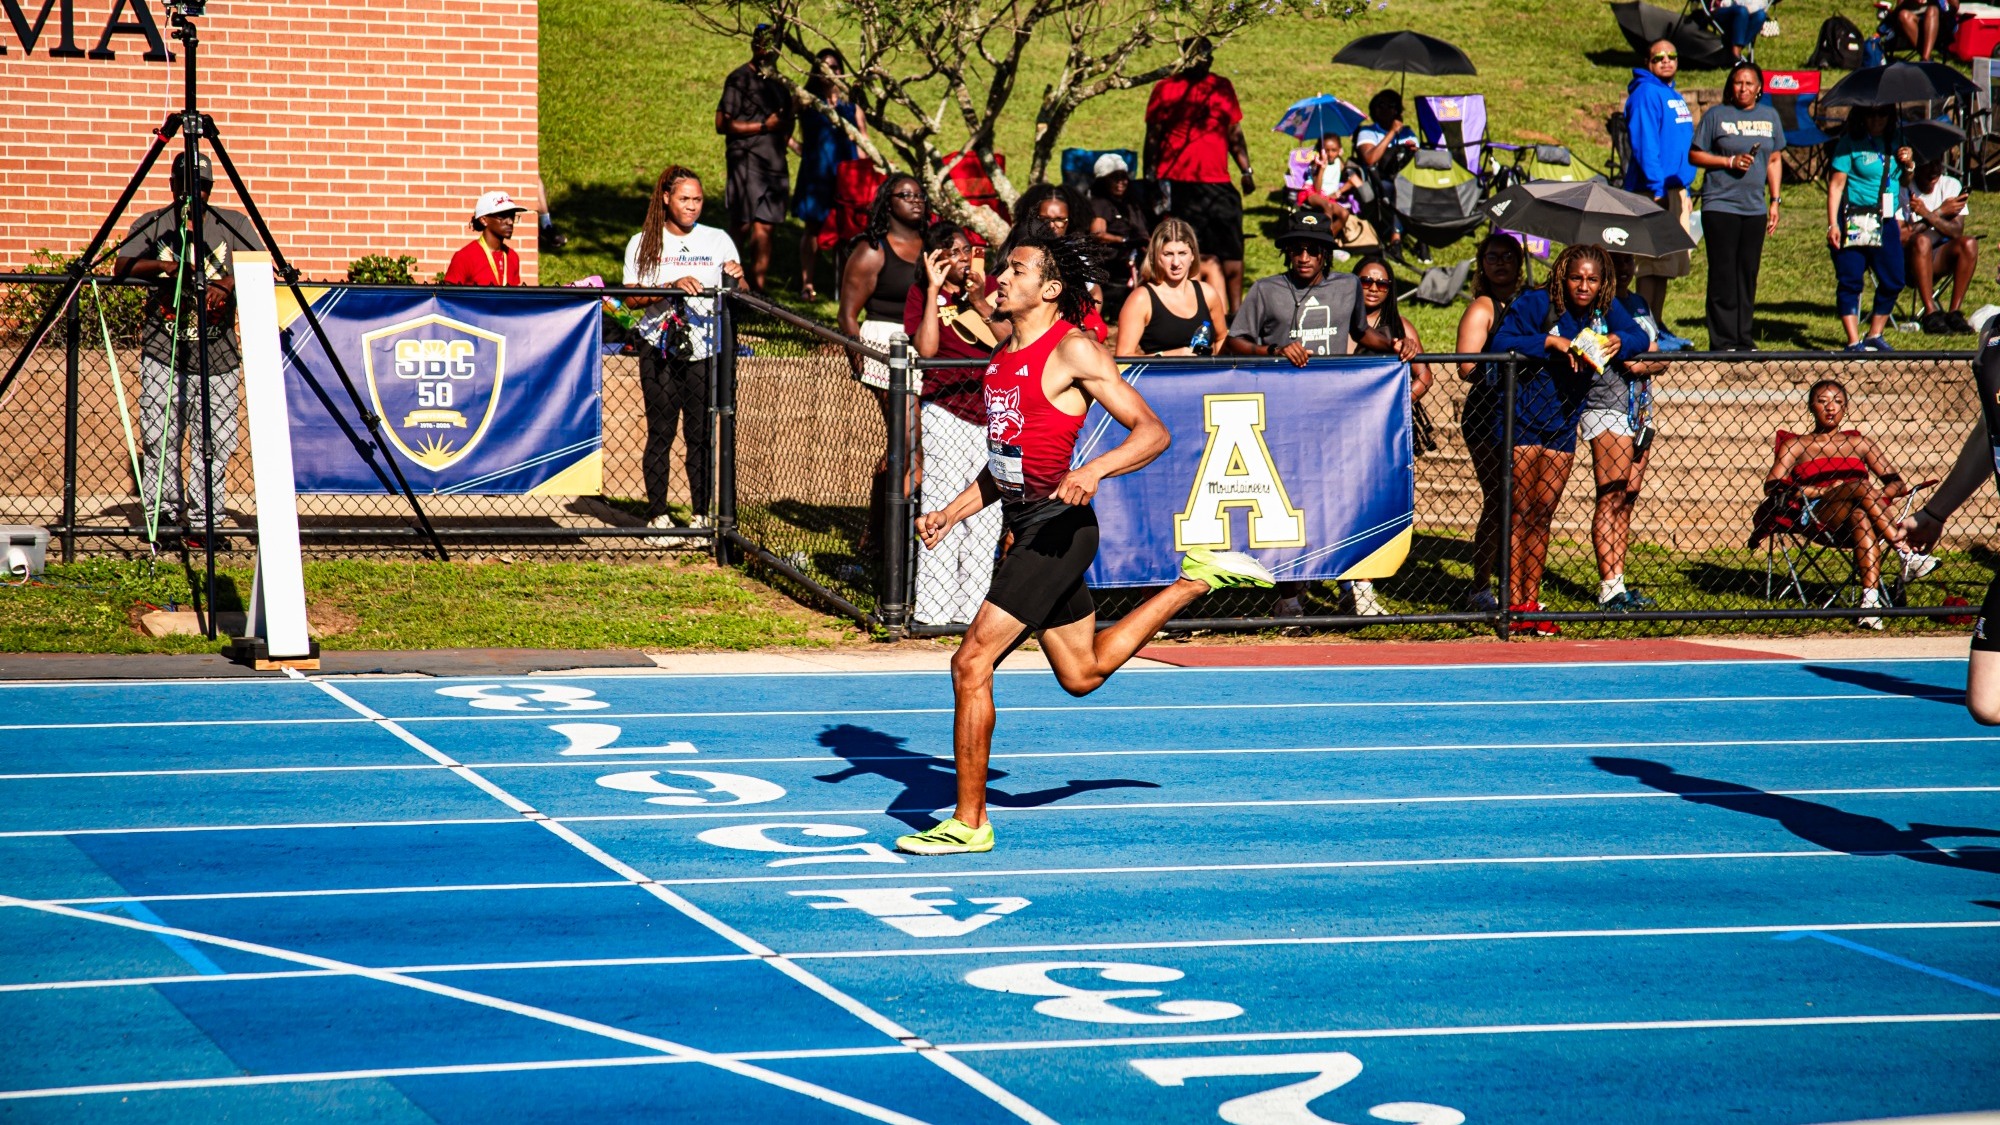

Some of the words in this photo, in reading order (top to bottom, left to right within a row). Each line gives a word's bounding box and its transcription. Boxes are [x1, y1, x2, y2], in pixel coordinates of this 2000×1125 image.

[394, 339, 475, 380] SBC
[418, 381, 453, 407] 50
[1173, 392, 1306, 552] A
[1207, 480, 1271, 494] Mountaineers
[434, 684, 611, 711] 8
[548, 723, 699, 756] 7
[696, 822, 908, 868] 5
[788, 886, 1033, 938] 4
[965, 962, 1244, 1024] 3
